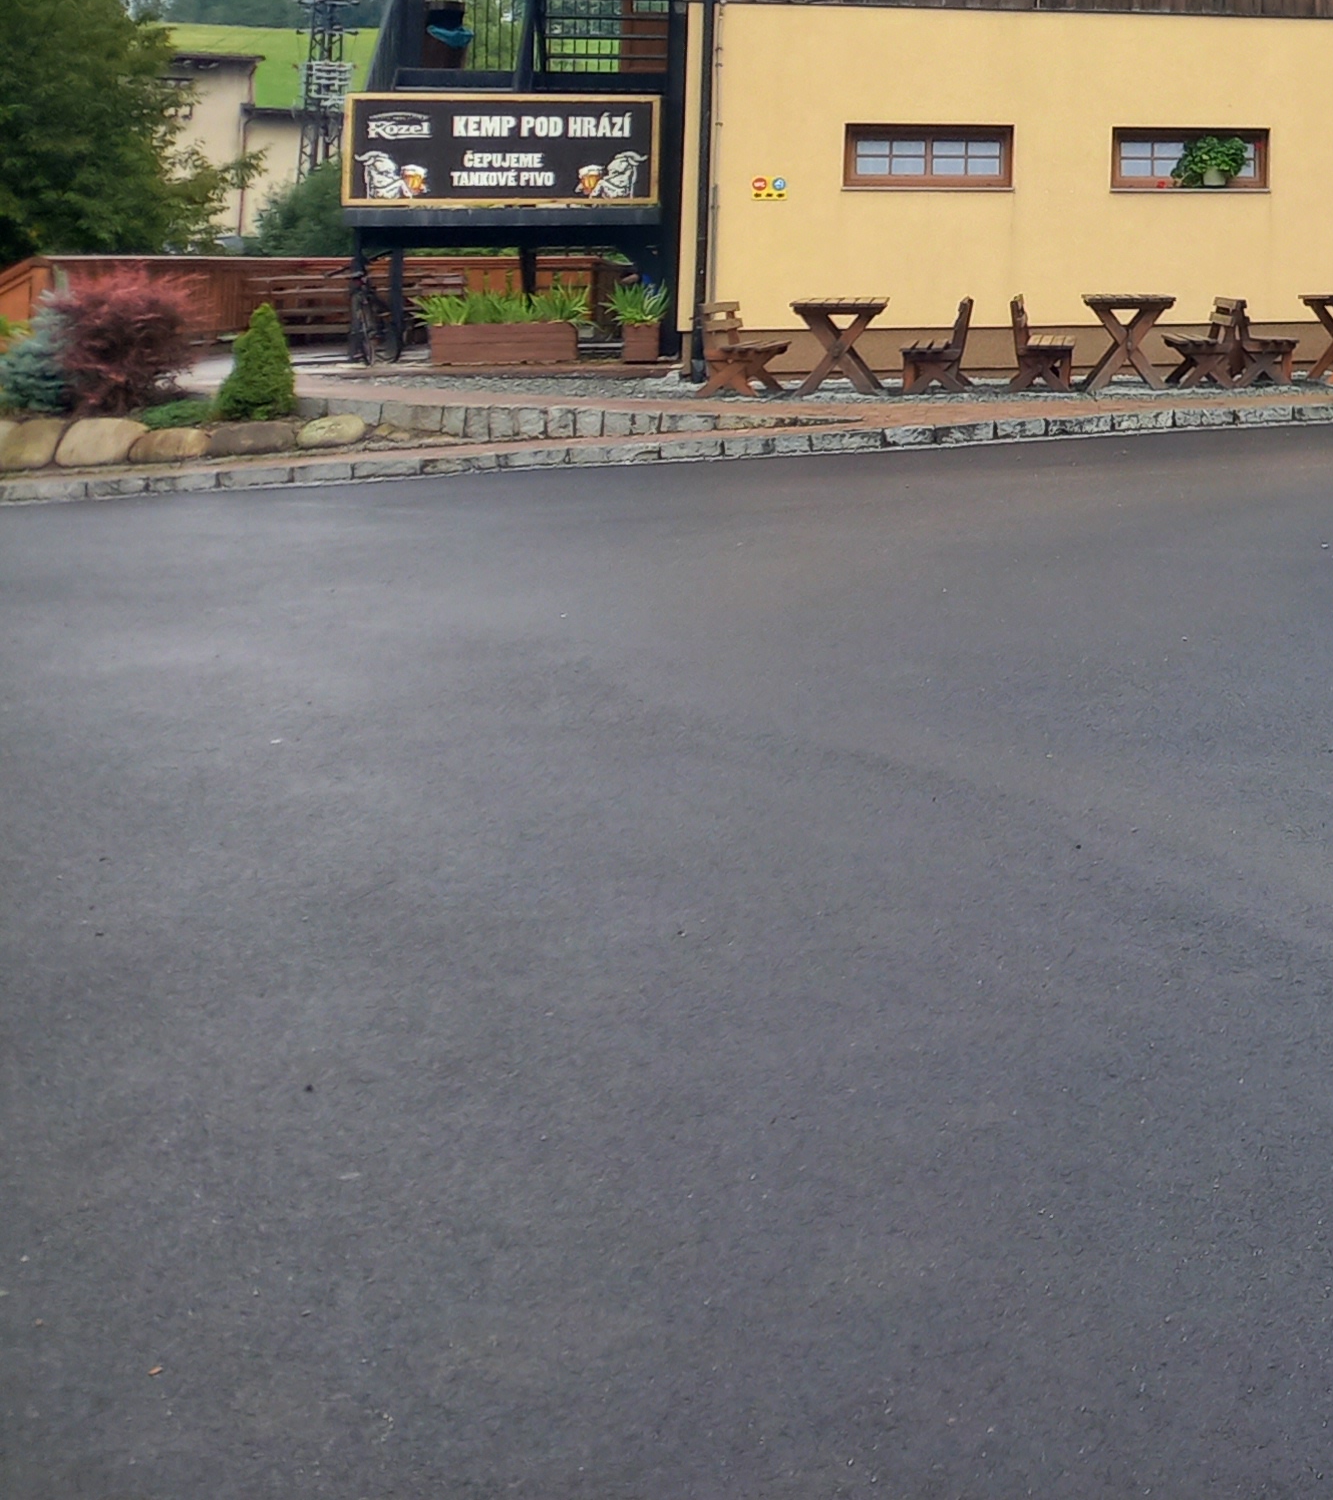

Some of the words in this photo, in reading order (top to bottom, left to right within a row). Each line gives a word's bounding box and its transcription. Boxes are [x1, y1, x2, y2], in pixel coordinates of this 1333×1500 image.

[367, 121, 432, 140] Kozel
[452, 115, 516, 138] KEMP
[520, 115, 564, 138] POD
[567, 112, 632, 138] HRÁZÍ
[463, 150, 544, 168] ČEPUJEME
[450, 169, 518, 187] TANKOVÉ
[519, 171, 555, 187] PIVO
